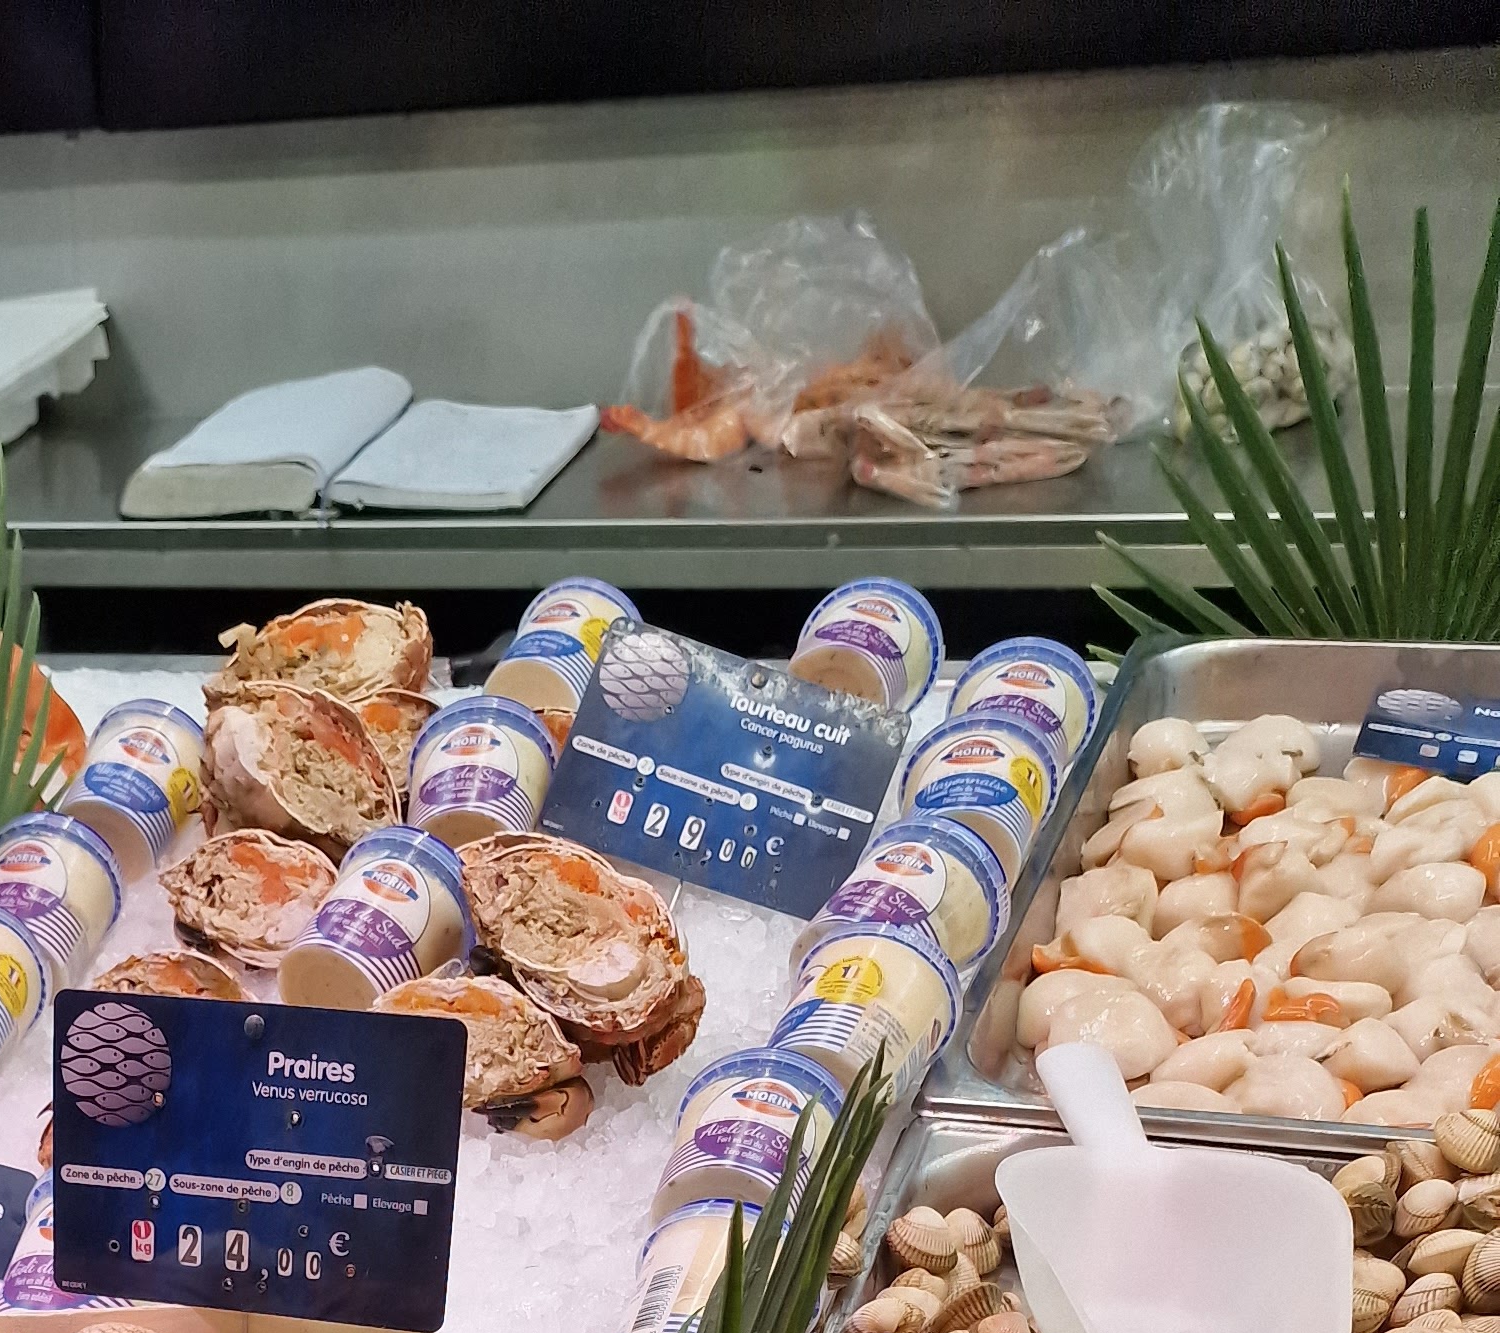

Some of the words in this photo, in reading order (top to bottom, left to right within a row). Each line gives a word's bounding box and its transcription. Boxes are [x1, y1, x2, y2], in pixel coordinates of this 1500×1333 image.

[1007, 669, 1046, 683] MORIN
[729, 694, 810, 733] Tourteau
[813, 720, 852, 745] cuit
[450, 735, 490, 749] MORIN
[740, 718, 779, 740] Cancer
[780, 730, 823, 754] pagurus
[950, 746, 995, 758] MORIN
[883, 852, 925, 871] MORIN
[370, 870, 411, 894] MORIN
[376, 914, 411, 951] Sud
[267, 1050, 356, 1083] Praires
[252, 1081, 295, 1100] Venus
[298, 1087, 368, 1106] verrucosa
[745, 1089, 793, 1109] MORIN
[247, 1152, 271, 1170] Type
[273, 1155, 309, 1175] d'engin
[312, 1158, 327, 1172] de
[65, 1167, 89, 1181] Zone
[91, 1169, 104, 1182] de
[145, 1173, 162, 1187] 27
[173, 1178, 224, 1195] Sous-zone
[226, 1182, 240, 1195] de
[371, 1197, 412, 1212] Elevage
[134, 1240, 152, 1255] kg
